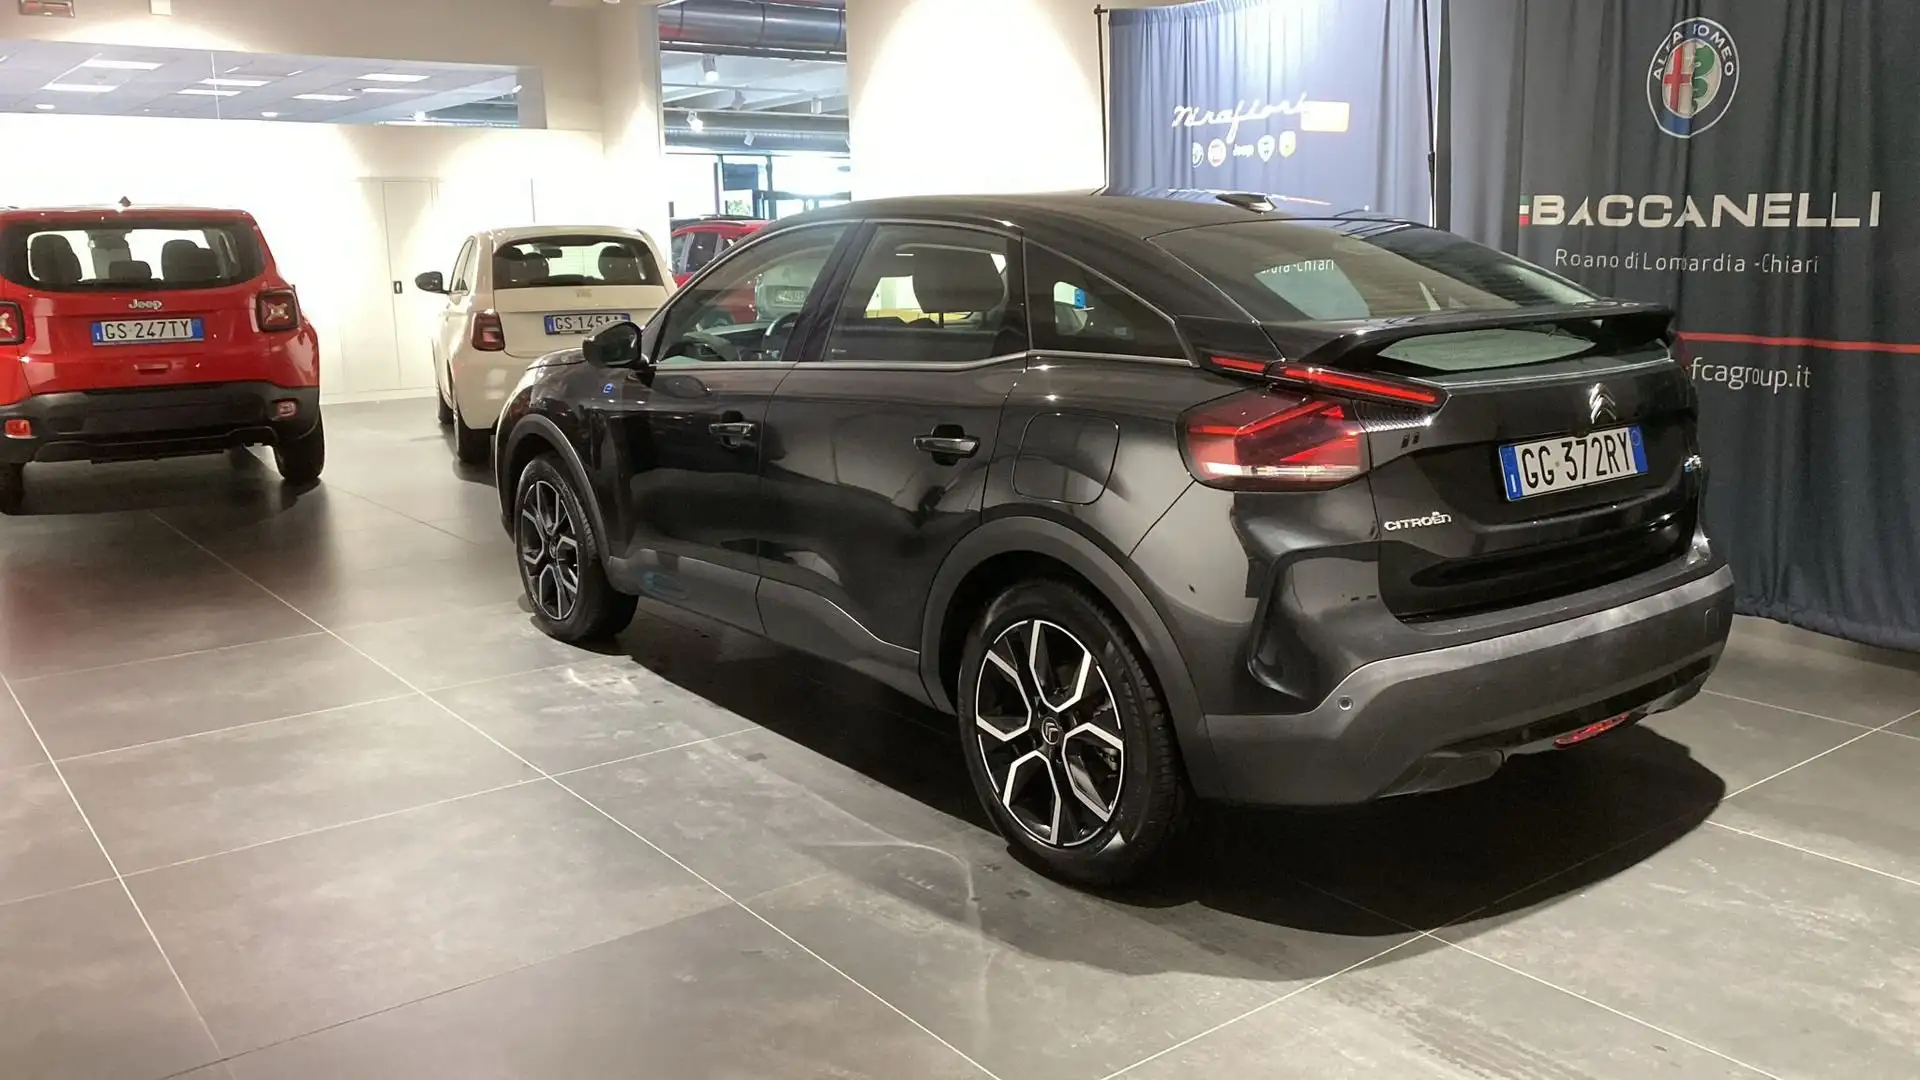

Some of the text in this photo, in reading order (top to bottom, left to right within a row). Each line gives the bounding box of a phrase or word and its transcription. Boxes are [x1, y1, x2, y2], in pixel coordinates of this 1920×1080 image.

[1532, 190, 1882, 228] BACCANELLI
[1624, 251, 1640, 270] di
[128, 299, 163, 310] Jeep
[105, 323, 127, 339] GS
[134, 320, 189, 338] 247TY
[555, 315, 618, 330] GS 145
[1690, 357, 1812, 394] fcagroup.it
[1521, 446, 1555, 489] GG
[1561, 431, 1630, 481] 372RY
